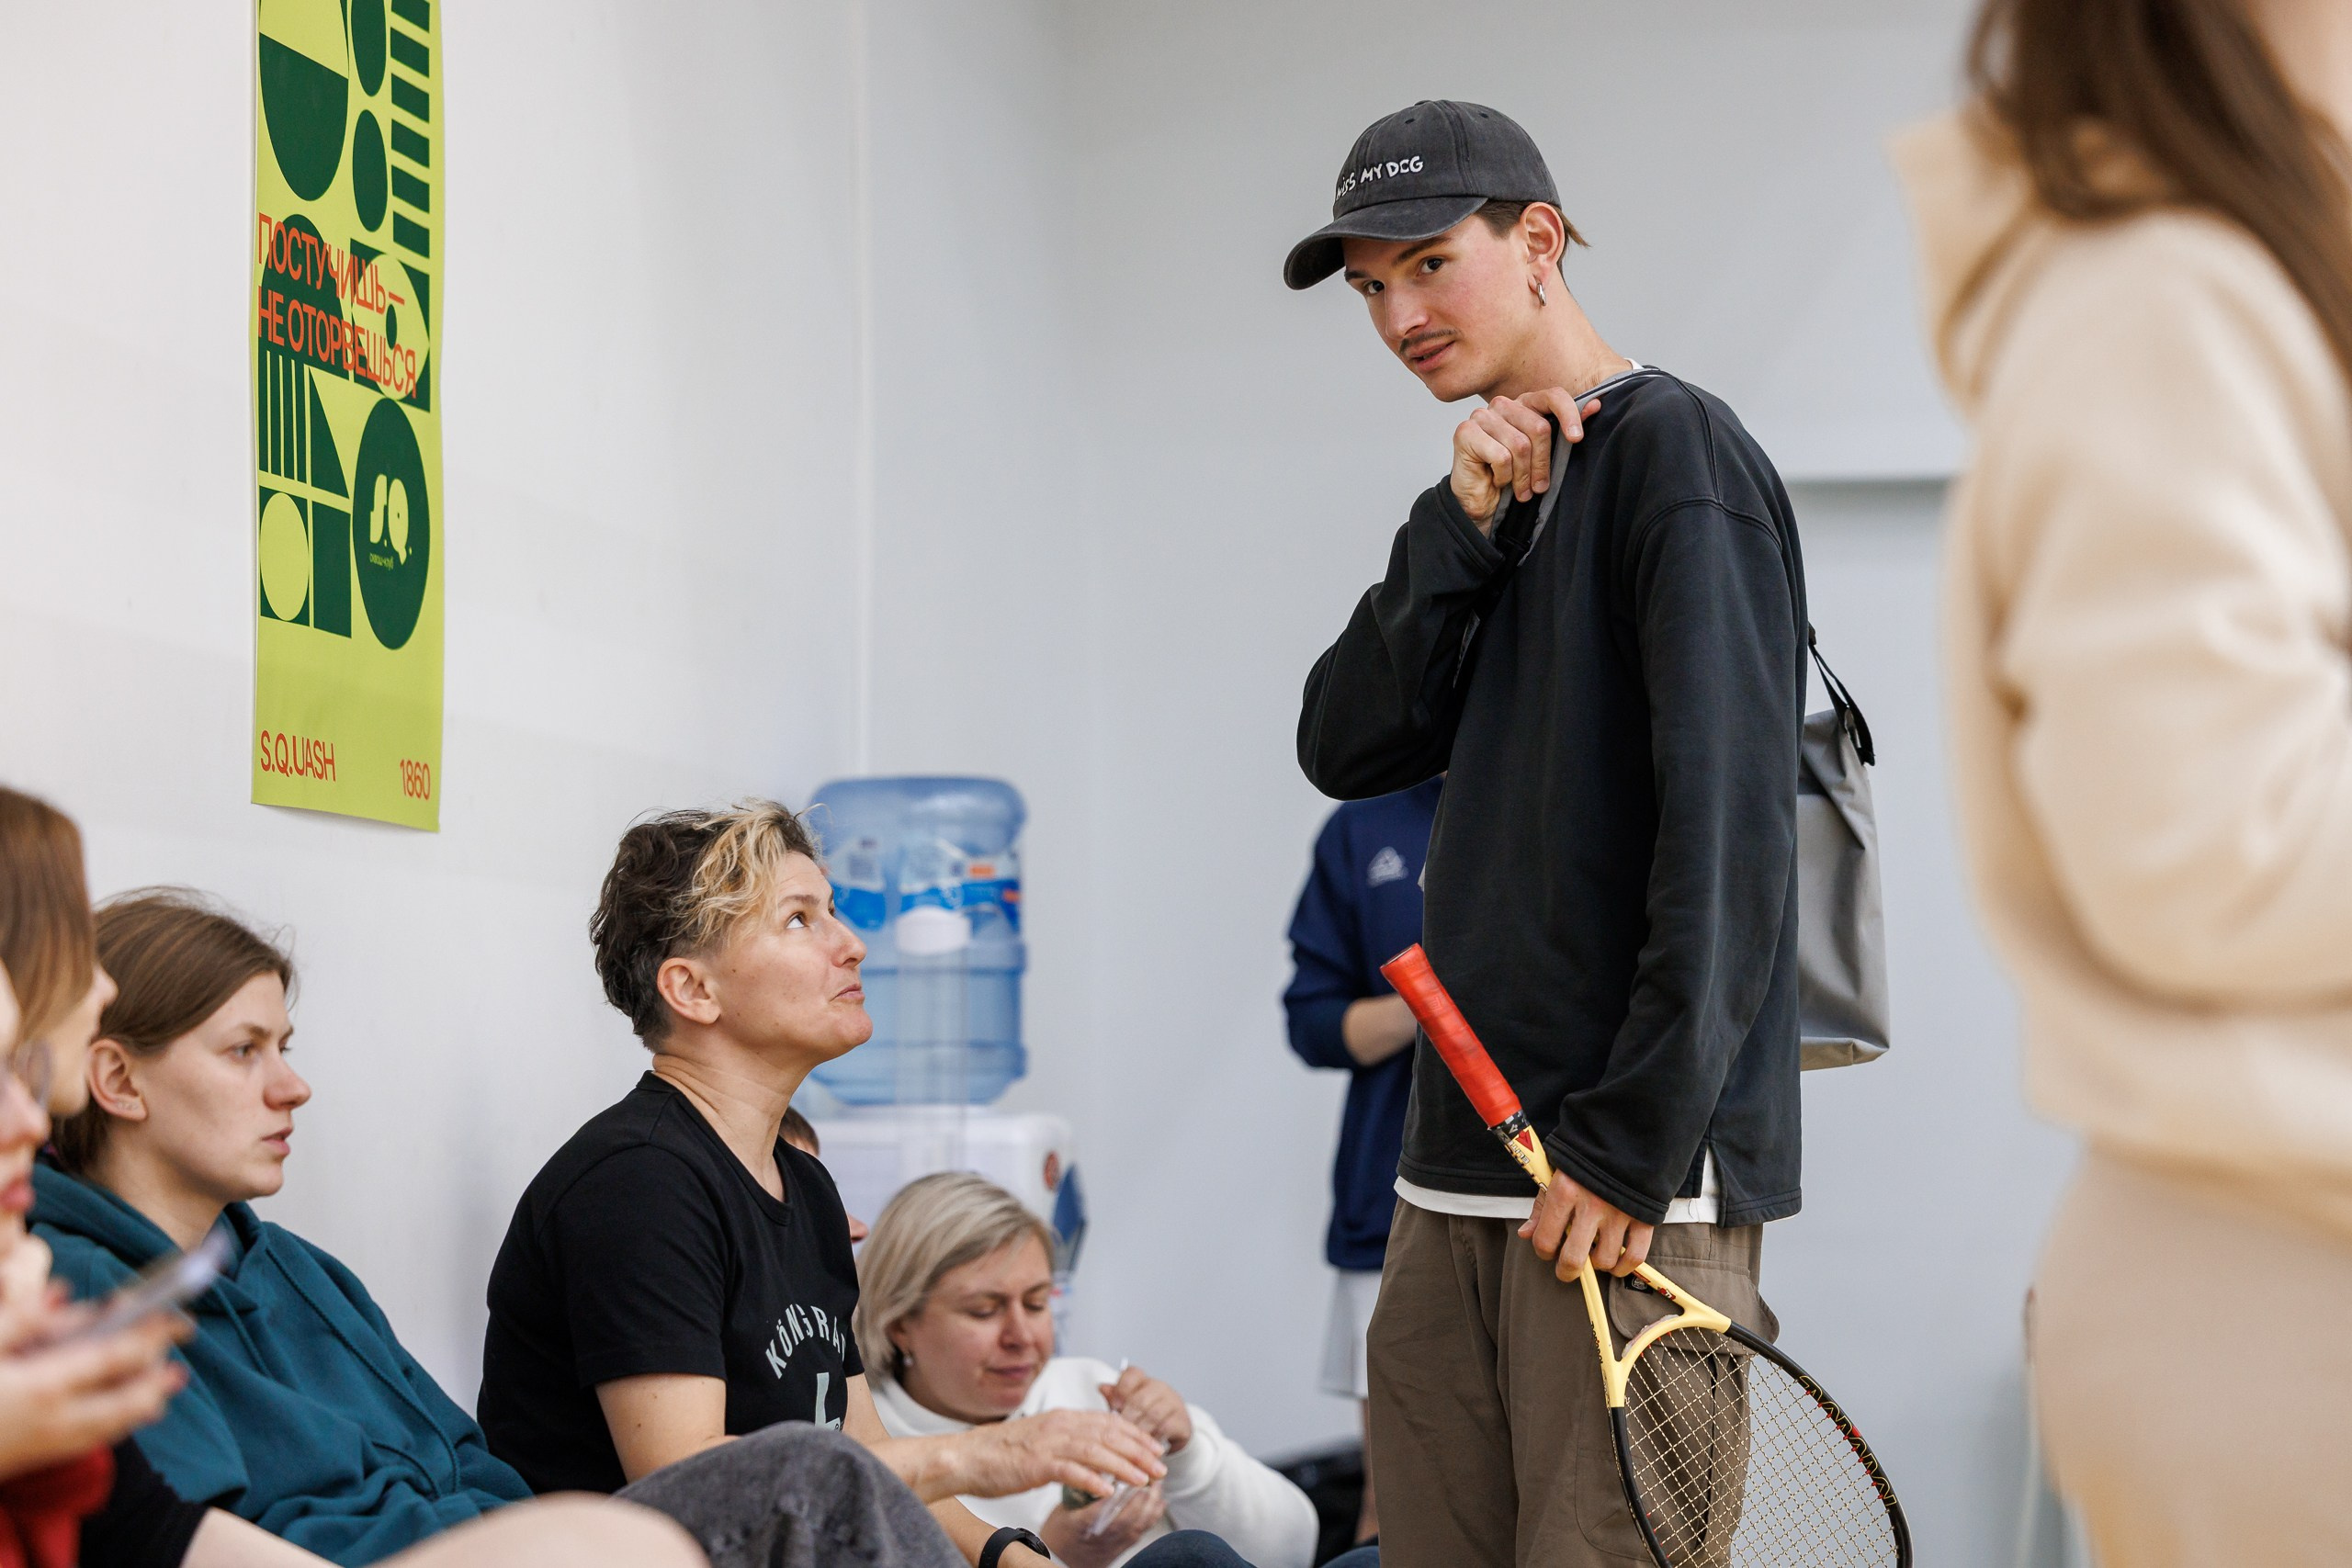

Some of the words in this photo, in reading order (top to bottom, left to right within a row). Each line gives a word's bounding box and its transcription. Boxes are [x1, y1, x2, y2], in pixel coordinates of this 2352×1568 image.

[1360, 164, 1383, 184] MY
[258, 211, 386, 315] ПОСТУЧИШЬ
[257, 285, 285, 346] НЕ
[287, 299, 417, 400] ОТОРВЕШЬСЯ
[260, 729, 336, 782] S.Q.UASH
[399, 758, 432, 801] 1860
